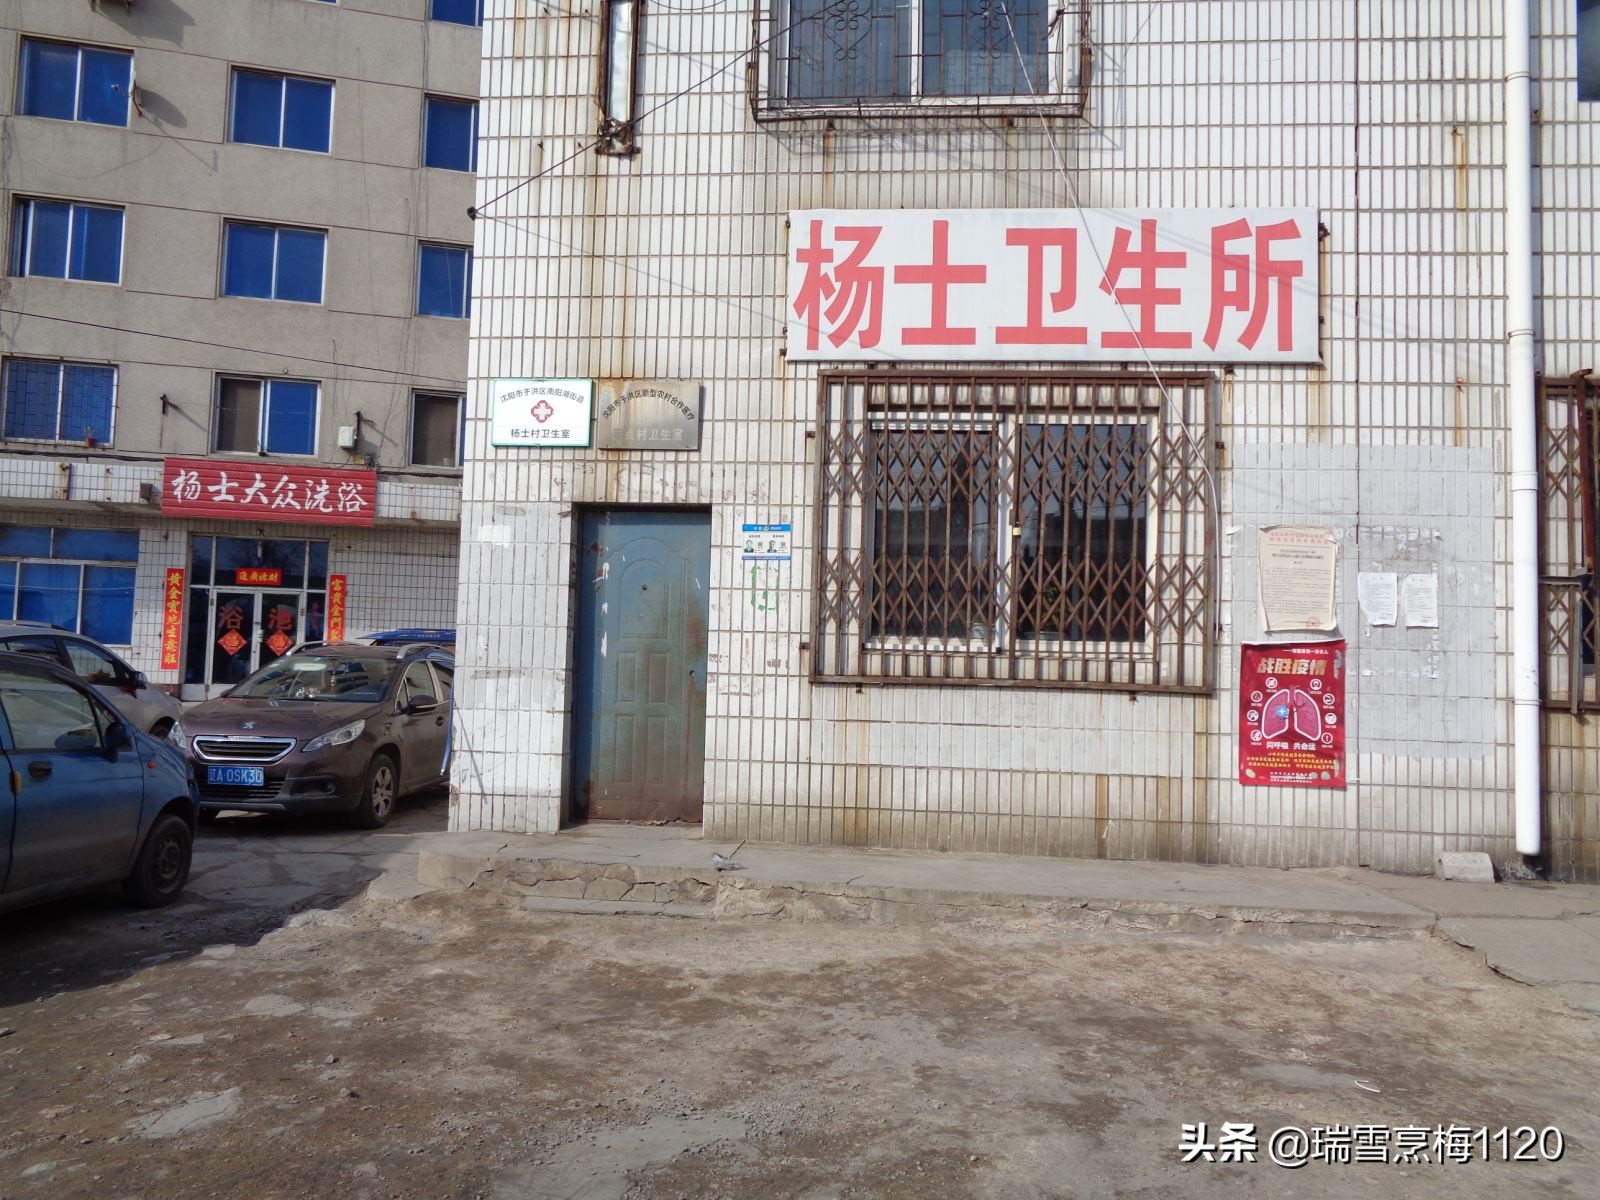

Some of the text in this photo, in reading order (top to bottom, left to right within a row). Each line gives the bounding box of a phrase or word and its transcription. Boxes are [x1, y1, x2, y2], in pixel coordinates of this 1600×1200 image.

[793, 217, 1303, 352] 杨士卫生所
[500, 387, 585, 404] 沈阳市于洪区南阳湖街道
[602, 388, 695, 421] 沈阳市于洪区新型农村合作医疗
[510, 428, 571, 439] 杨士村卫生室
[171, 469, 368, 513] 杨士大众洗浴
[218, 605, 244, 629] 浴
[1256, 657, 1328, 676] 战胜疫情
[1266, 741, 1289, 750] 同呼吸
[1293, 742, 1316, 751] 共命运
